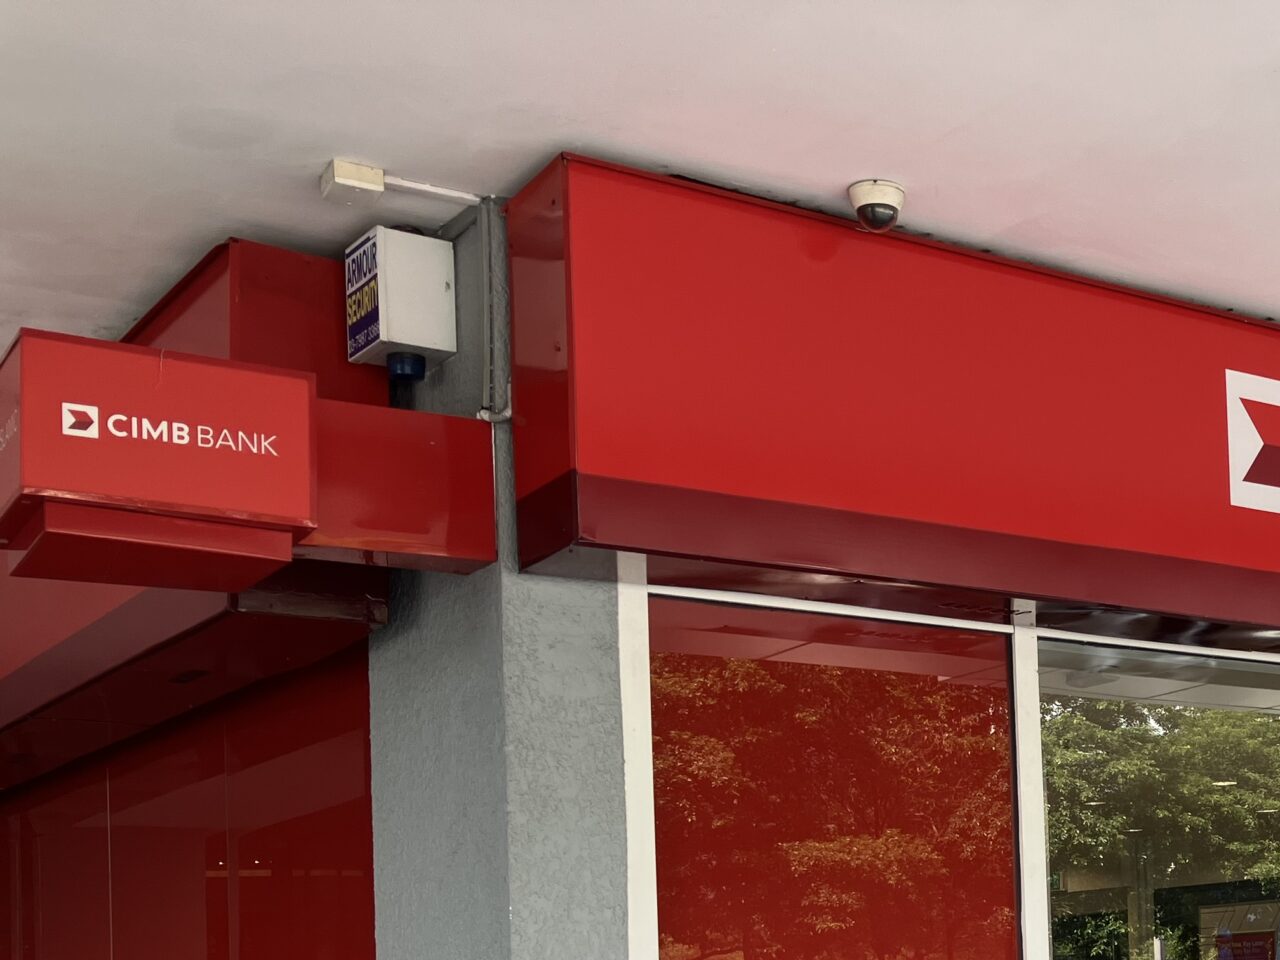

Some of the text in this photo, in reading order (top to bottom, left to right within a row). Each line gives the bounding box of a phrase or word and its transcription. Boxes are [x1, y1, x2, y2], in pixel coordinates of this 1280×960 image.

[347, 241, 377, 292] ARMOUR
[107, 413, 279, 457] CIMB BANK
